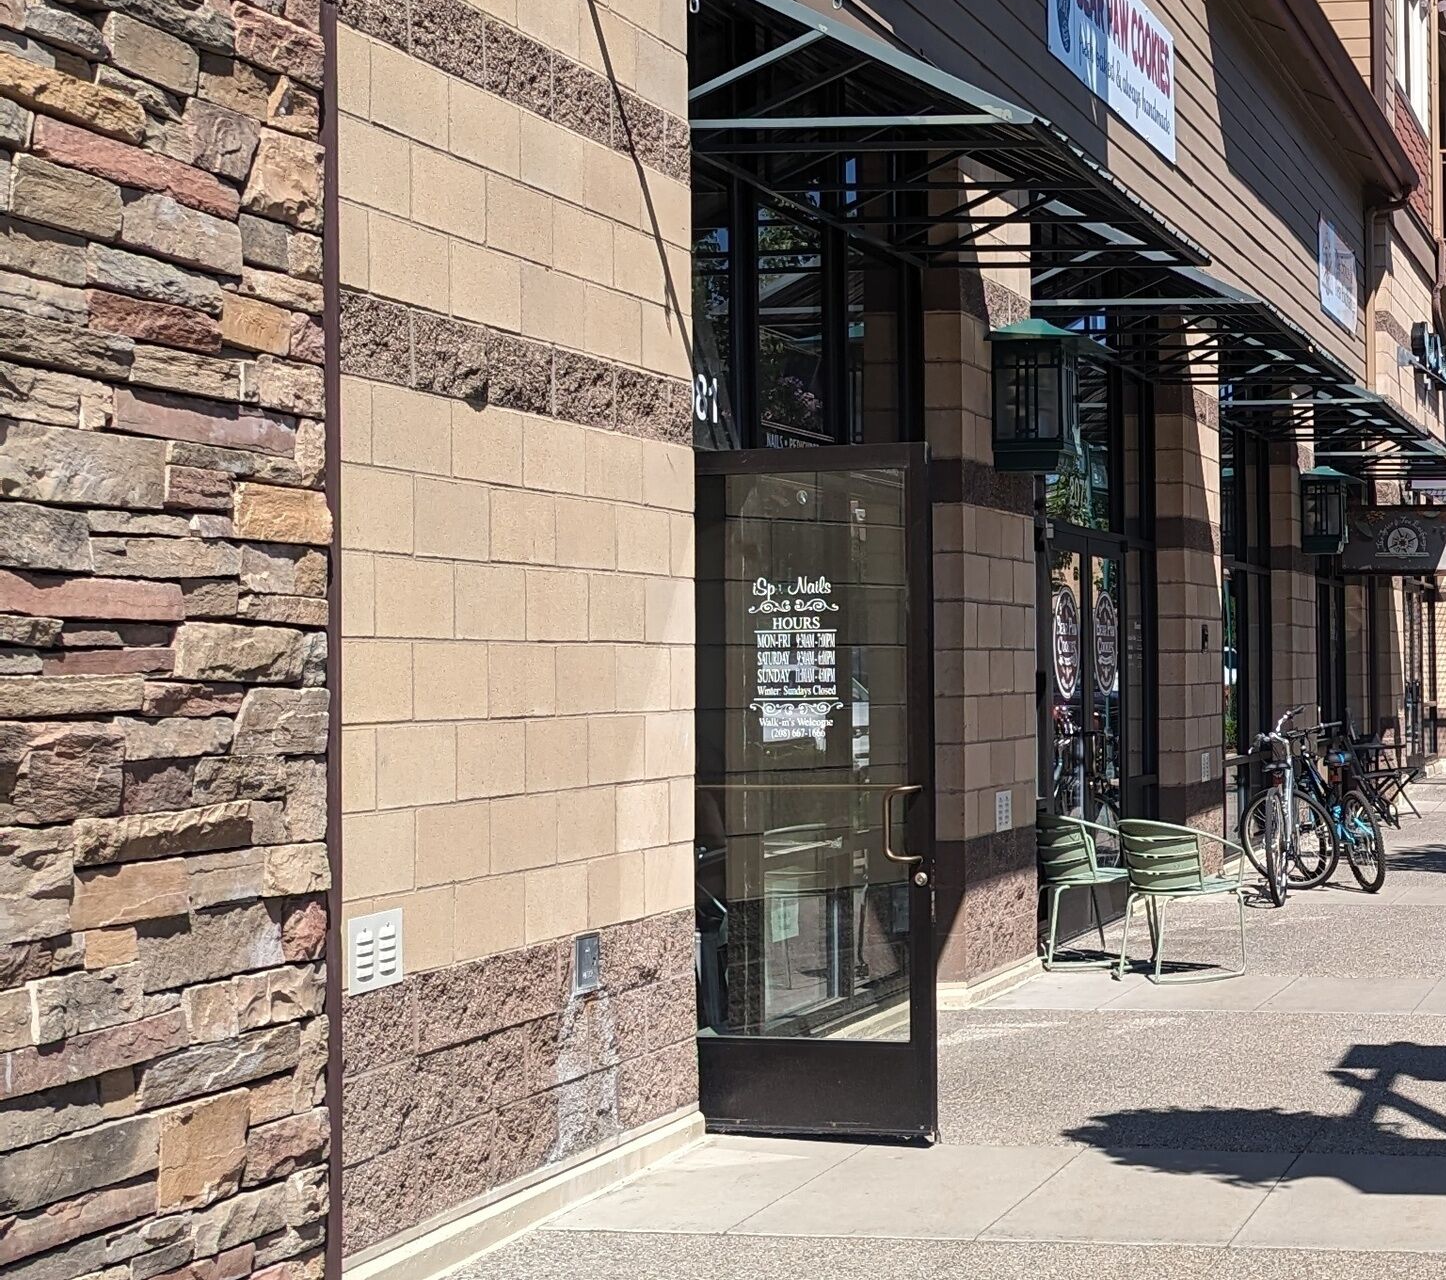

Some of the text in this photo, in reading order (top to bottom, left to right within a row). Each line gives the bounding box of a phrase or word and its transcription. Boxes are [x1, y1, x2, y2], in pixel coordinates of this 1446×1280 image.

[1131, 7, 1171, 100] COOKIES
[1142, 86, 1171, 135] handmade
[787, 576, 831, 595] Nails
[772, 617, 821, 630] HOURS
[757, 633, 791, 648] MON-FRI
[757, 650, 791, 666] SATURDAY
[757, 668, 791, 683] SUNDAY
[812, 685, 837, 696] Closed
